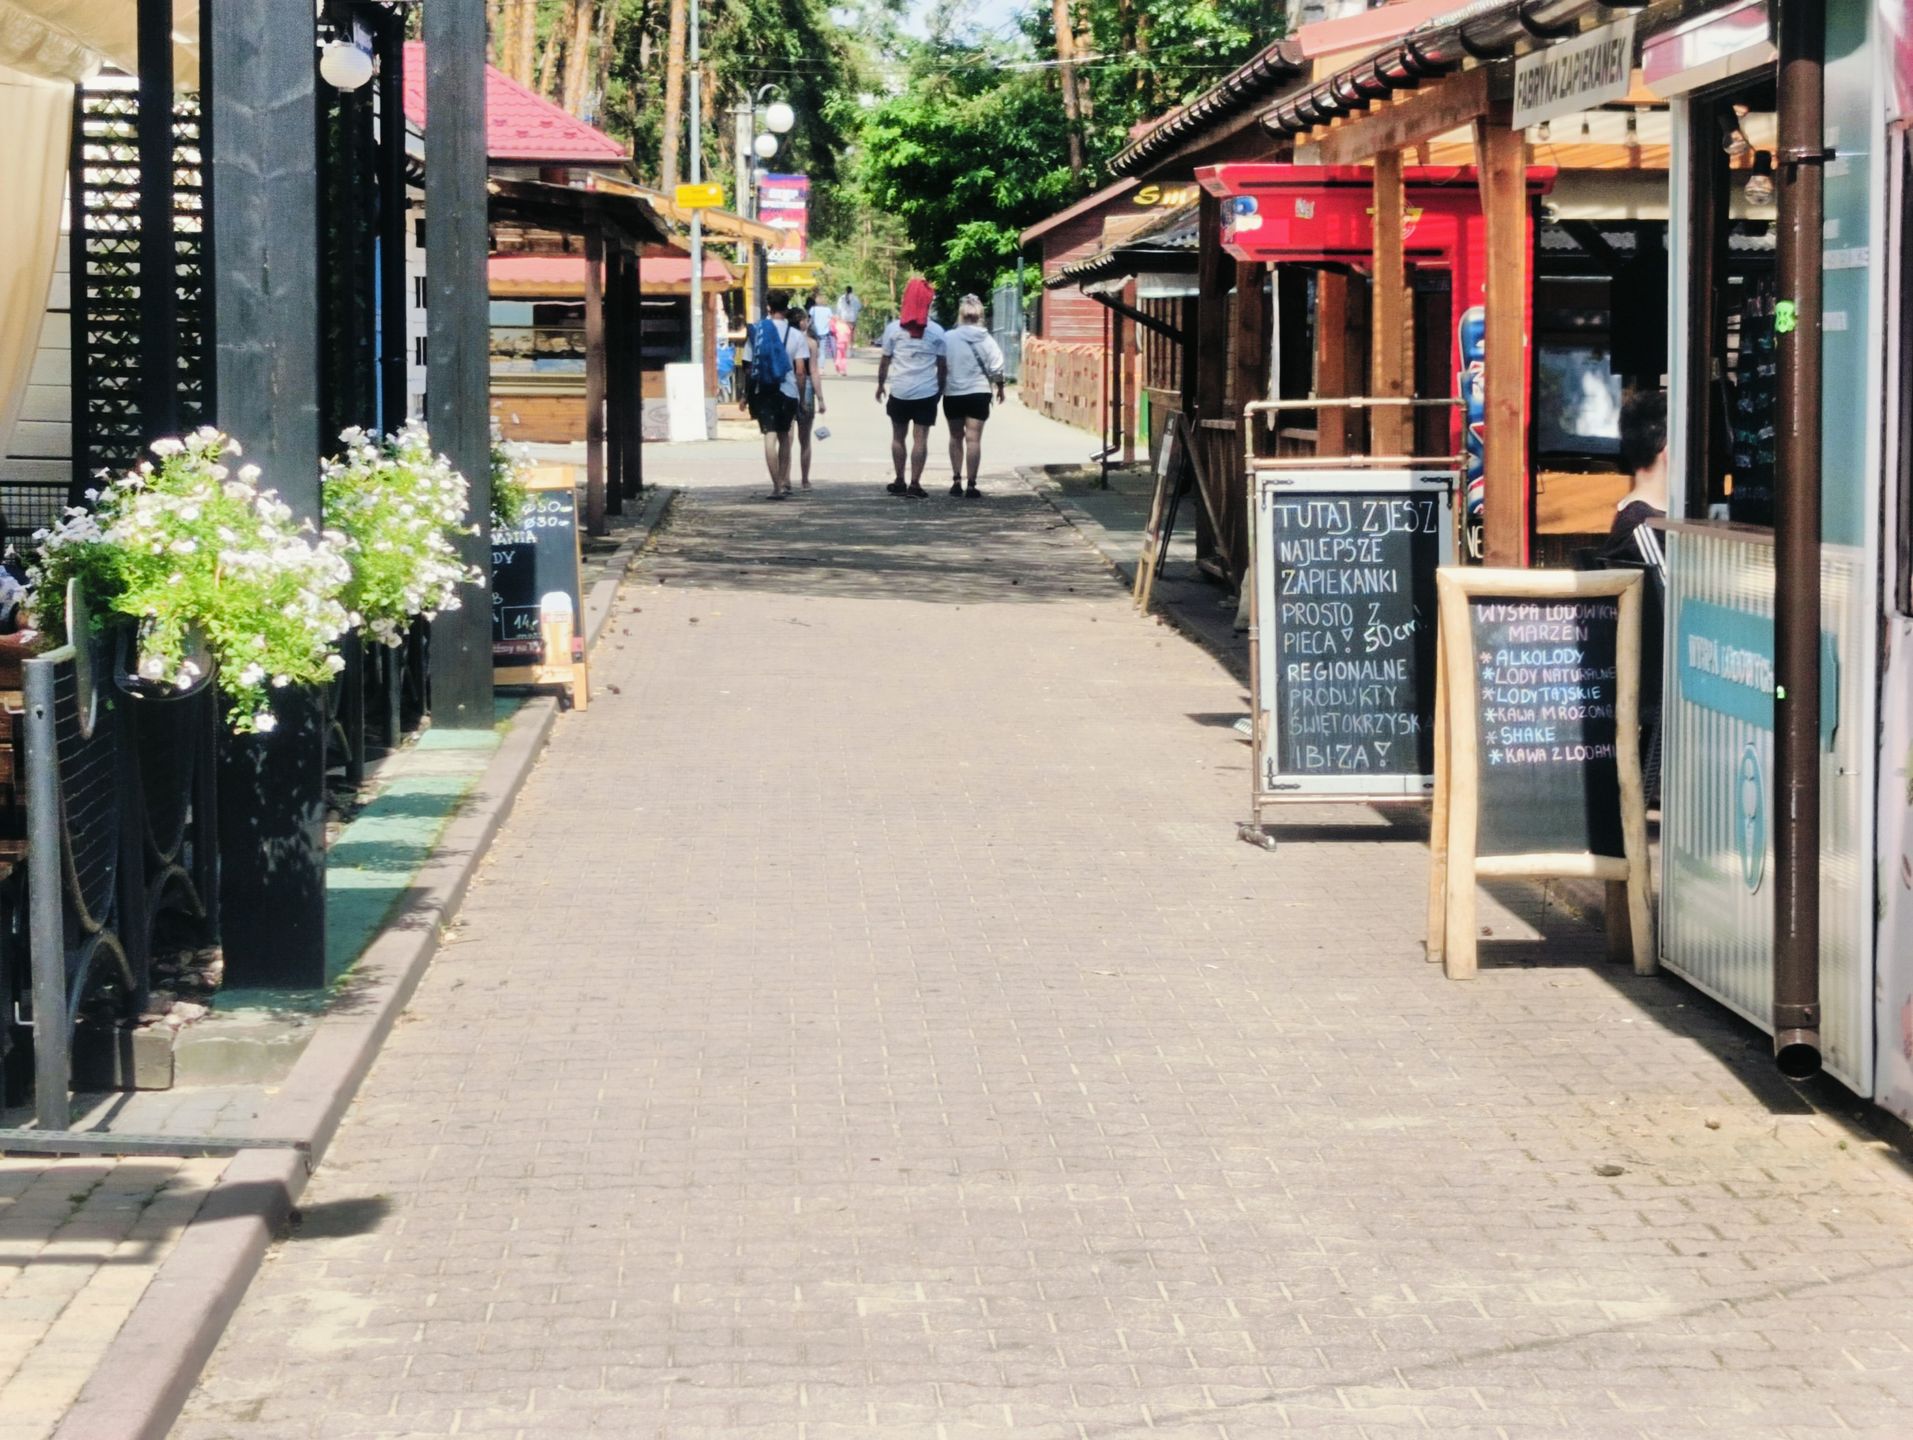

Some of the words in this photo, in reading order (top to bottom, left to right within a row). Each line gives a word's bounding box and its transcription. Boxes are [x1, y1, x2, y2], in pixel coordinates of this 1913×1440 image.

[1517, 60, 1559, 112] FABRYKA
[1559, 37, 1626, 99] ZAPIEKANEK
[1273, 501, 1351, 535] TUTAJ
[1362, 500, 1437, 536] ZJESZ
[1281, 538, 1384, 567] NAJLEPSZE
[1281, 568, 1397, 595] ZAPIEKANKI
[1282, 602, 1353, 626] PROSTO
[1367, 602, 1381, 626] Z
[1477, 604, 1540, 623] WYSPA
[1495, 650, 1584, 666] ALKOLODY
[1287, 659, 1408, 682] REGIONALNE
[1495, 668, 1538, 684] LODY
[1289, 685, 1397, 708] PRODUKTY
[1496, 687, 1538, 704] LODY
[1538, 685, 1601, 705] TAJSKIE
[1497, 710, 1536, 723] KAWA
[1501, 726, 1556, 745] SHAKE
[1505, 747, 1547, 763] KAWA
[1552, 747, 1563, 761] Z
